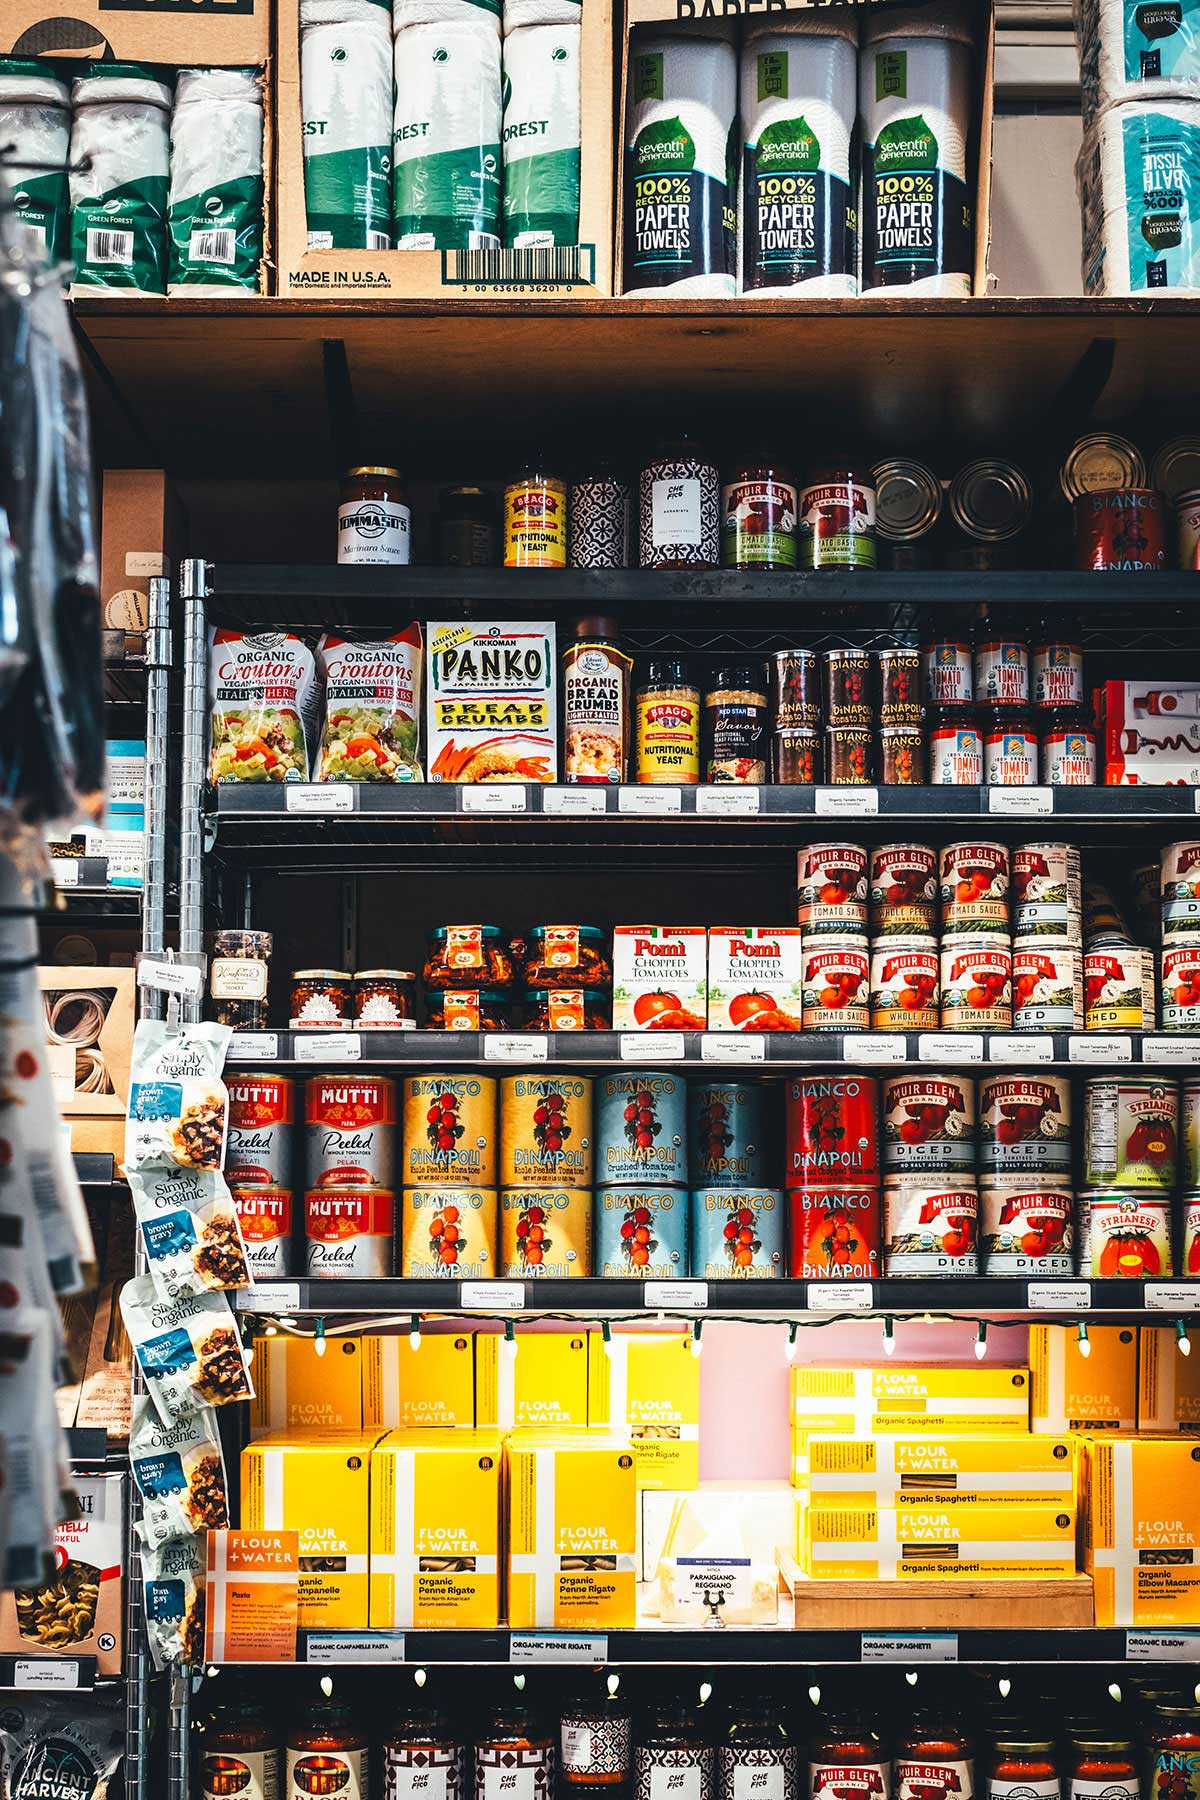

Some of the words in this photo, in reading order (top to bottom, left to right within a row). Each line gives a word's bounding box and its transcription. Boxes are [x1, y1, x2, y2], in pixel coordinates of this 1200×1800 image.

[502, 120, 549, 144] OREST
[639, 141, 683, 155] seventh
[762, 141, 809, 155] seventh
[639, 151, 684, 162] generation
[762, 151, 809, 162] generation
[1142, 154, 1182, 171] TISSUE
[635, 178, 691, 195] 100%
[758, 178, 815, 195] 100%
[1142, 170, 1183, 192] BATH
[635, 195, 691, 206] RECYCLED
[758, 195, 815, 205] RECYCLED
[1144, 198, 1184, 210] 100%
[87, 214, 108, 222] GREEN
[109, 216, 134, 224] FOREST
[636, 204, 690, 230] PAPER
[758, 203, 815, 229] PAPER
[636, 229, 691, 250] TOWELS
[759, 229, 815, 250] TOWELS
[289, 272, 330, 283] MADE
[334, 272, 349, 283] IN
[352, 271, 391, 283] U.S.A.
[667, 491, 683, 500] FICO
[668, 485, 684, 494] CHE
[736, 486, 762, 500] MUIR
[766, 486, 789, 501] GLEN
[517, 494, 553, 506] BRAGG
[339, 513, 407, 532] TOMMASO'S
[511, 533, 558, 546] NUTRITIONAL
[522, 543, 548, 552] YEAST
[473, 639, 517, 647] KIKKOMAN
[237, 651, 295, 664] ORGANIC
[344, 652, 404, 664] ORGANIC
[442, 649, 543, 681] PANKO
[831, 660, 870, 671] BIANCO
[880, 658, 920, 670] BIANCO
[218, 661, 305, 681] Croutons
[327, 661, 413, 681] Croutons
[998, 669, 1024, 684] TOMATO
[567, 677, 619, 688] ORGANIC
[932, 670, 961, 685] TOMATO
[328, 687, 374, 700] ITALIAN
[567, 689, 619, 700] BREAD
[936, 685, 958, 699] PASTE
[1001, 684, 1023, 698] PASTE
[442, 704, 543, 714] BREAD
[567, 700, 619, 712] CRUMBS
[568, 711, 593, 720] LIGHTLY
[594, 712, 619, 720] SALTED
[651, 706, 688, 720] BRAGG
[442, 714, 543, 725] CRUMBS
[715, 718, 763, 741] Savory
[882, 736, 922, 747] BIANCO
[644, 747, 694, 756] NUTRITIONAL
[657, 756, 682, 765] YEAST
[1000, 760, 1029, 775] TOMATO
[813, 851, 839, 866] MUIR
[843, 852, 865, 868] GLEN
[948, 848, 974, 863] MUIR
[976, 848, 1001, 863] GLEN
[822, 862, 858, 871] ORGANIC
[814, 907, 844, 917] TOMATO
[847, 908, 865, 918] SAUCE
[948, 905, 976, 915] TOMATO
[979, 905, 1001, 914] SAUCE
[635, 957, 686, 968] CHOPPED
[632, 968, 689, 978] TOMATOES
[890, 1012, 918, 1021] WHOLE
[411, 1079, 481, 1097] BIANCO
[607, 1078, 675, 1095] BIANCO
[792, 1082, 860, 1100] BIANCO
[893, 1084, 921, 1099] MUIR
[926, 1083, 955, 1099] GLEN
[321, 1090, 378, 1104] MUTTI
[323, 1131, 374, 1156] Peeled
[607, 1147, 677, 1163] DiNAPOLI
[897, 1145, 953, 1155] DICED
[411, 1150, 480, 1165] DiNAPOLI
[793, 1151, 862, 1169] DiNAPOLI
[426, 1166, 449, 1174] Peeled
[451, 1166, 481, 1174] Tomatoes
[608, 1163, 639, 1172] Crushed
[641, 1163, 676, 1172] Tomatoes
[154, 1178, 199, 1196] Simply
[705, 1194, 776, 1211] BIANCO
[1100, 1214, 1157, 1228] STRIANESE
[147, 1221, 175, 1236] brown
[150, 1231, 174, 1242] gravy
[404, 1401, 446, 1411] FLOUR
[412, 1412, 456, 1422] WATER
[419, 1528, 467, 1539] FLOUR
[232, 1538, 282, 1549] FLOUR
[416, 1541, 426, 1551] +
[428, 1541, 479, 1552] WATER
[229, 1553, 239, 1562] +
[242, 1553, 293, 1563] WATER
[902, 1564, 936, 1573] Organic
[937, 1564, 980, 1574] Spaghetti
[419, 1578, 453, 1587] Organic
[419, 1586, 446, 1594] Penne
[448, 1586, 476, 1596] Rigate
[512, 1642, 545, 1650] ORGANIC
[567, 1643, 592, 1651] RIGATE
[863, 1642, 895, 1650] ORGANIC
[896, 1642, 932, 1650] SPAGHETTI
[1128, 1638, 1160, 1647] ORGANIC
[1161, 1639, 1185, 1647] ELBOW
[22, 1767, 91, 1789] ANCIENT
[501, 1774, 518, 1783] CHE
[820, 1769, 846, 1782] MUIR
[849, 1770, 875, 1783] GLEN
[499, 1781, 517, 1790] FICO
